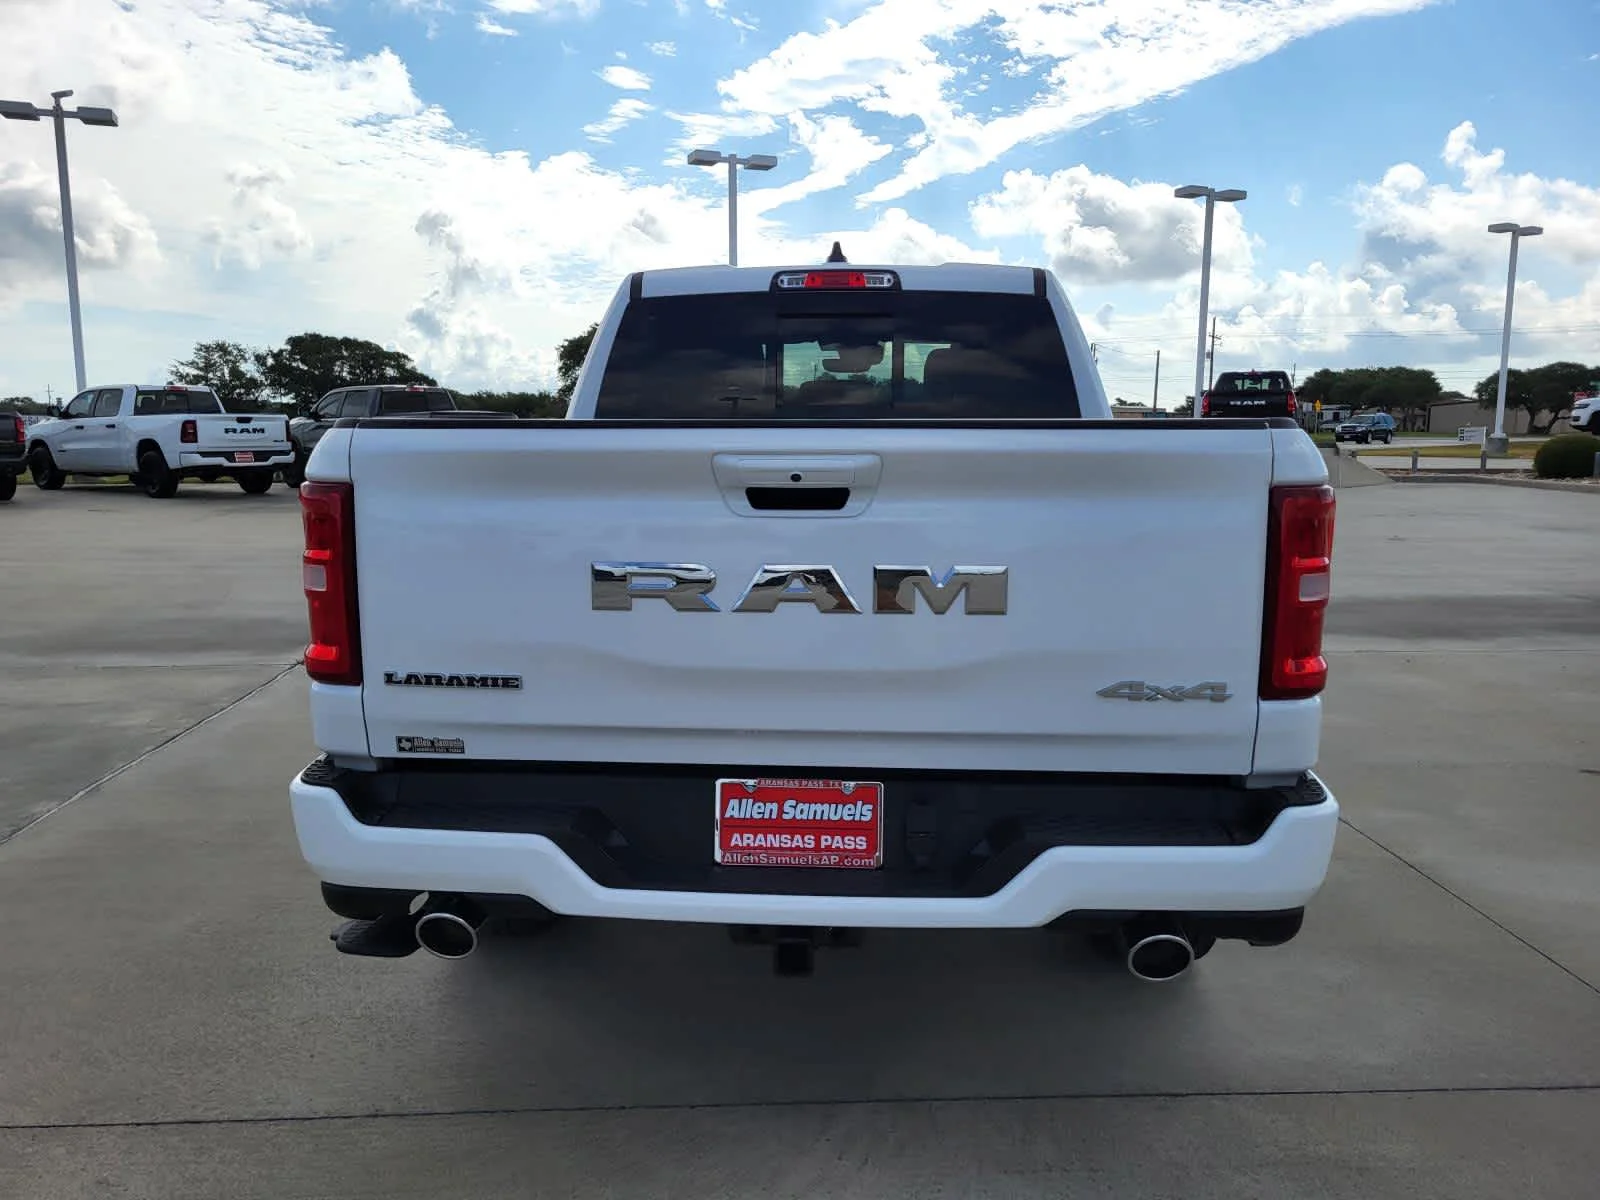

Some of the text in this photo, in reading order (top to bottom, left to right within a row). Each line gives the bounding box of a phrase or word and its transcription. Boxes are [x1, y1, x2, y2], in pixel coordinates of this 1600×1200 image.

[592, 561, 1009, 615] RAM
[384, 671, 522, 689] LARAMIE
[760, 778, 799, 787] ARANSAS
[724, 798, 873, 821] Allen Samuels
[730, 832, 867, 850] ARANSAS PASS
[723, 852, 874, 867] AllenSamuelsAP.com
